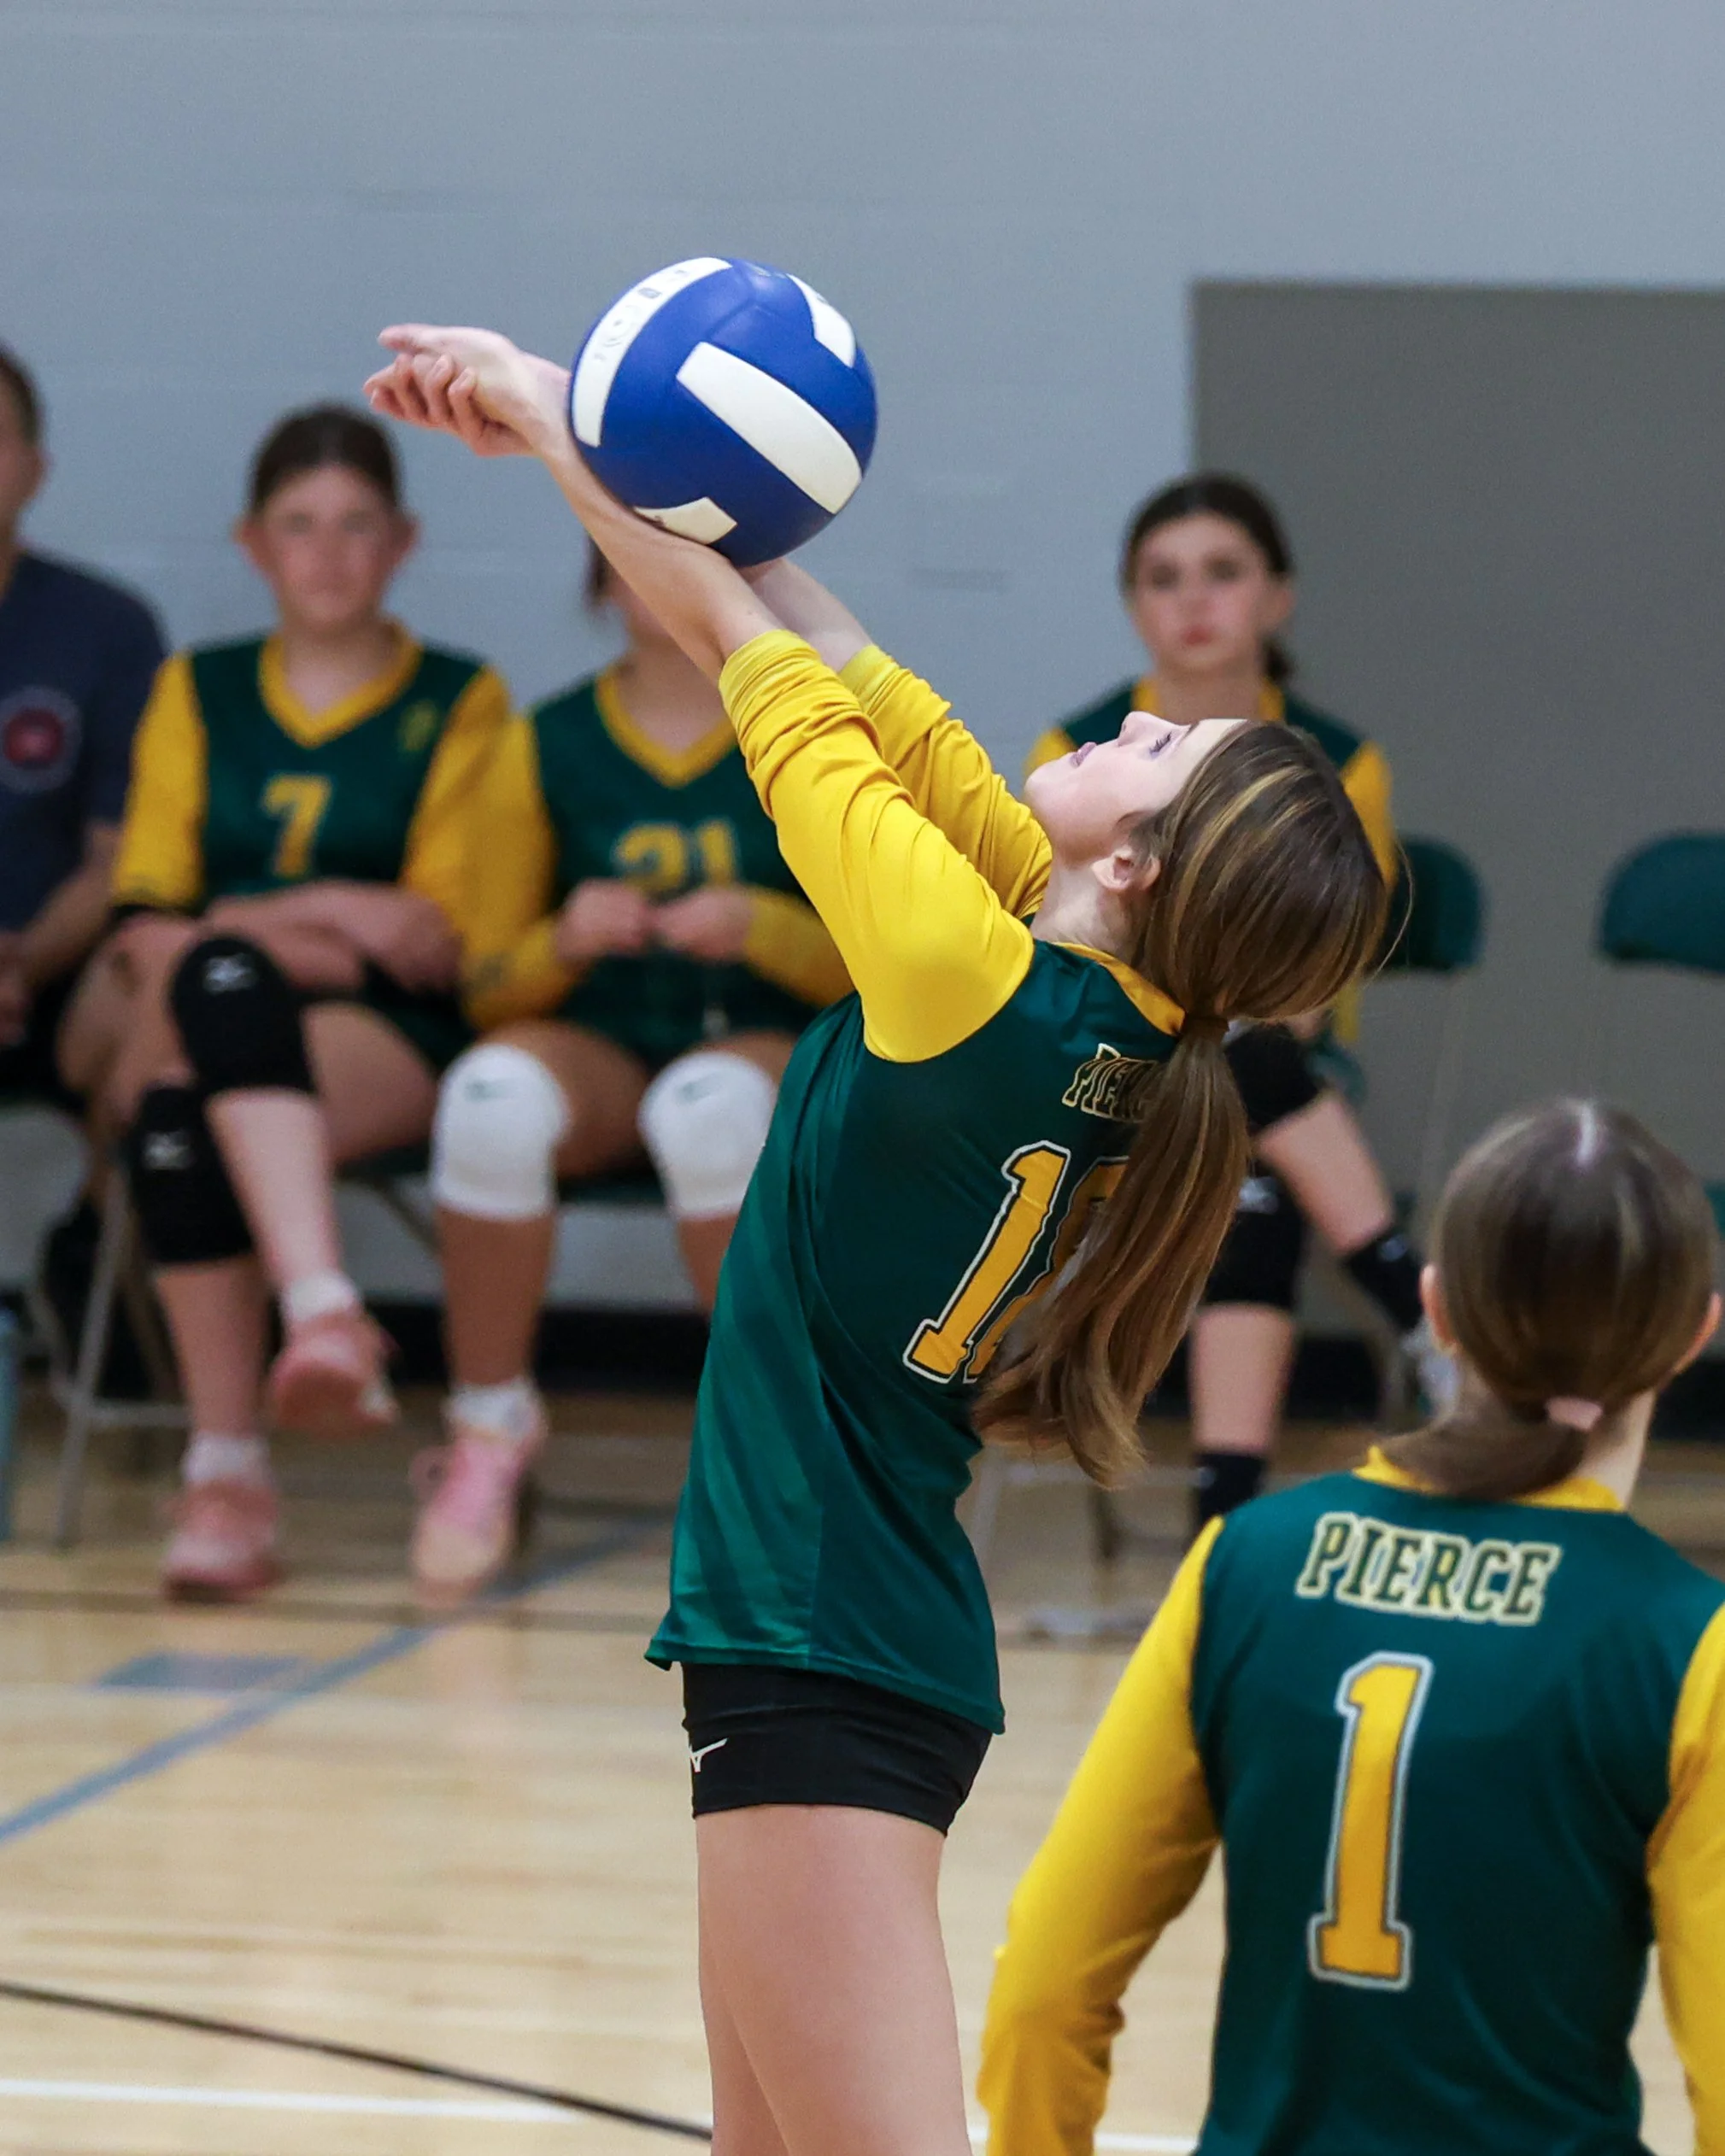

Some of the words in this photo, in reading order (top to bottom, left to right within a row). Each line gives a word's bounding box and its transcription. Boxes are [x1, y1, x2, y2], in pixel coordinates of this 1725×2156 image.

[261, 771, 333, 879] 7
[1061, 1042, 1156, 1124] PIER
[1295, 1511, 1563, 1626] PIERCE
[1307, 1650, 1435, 1992] 1
